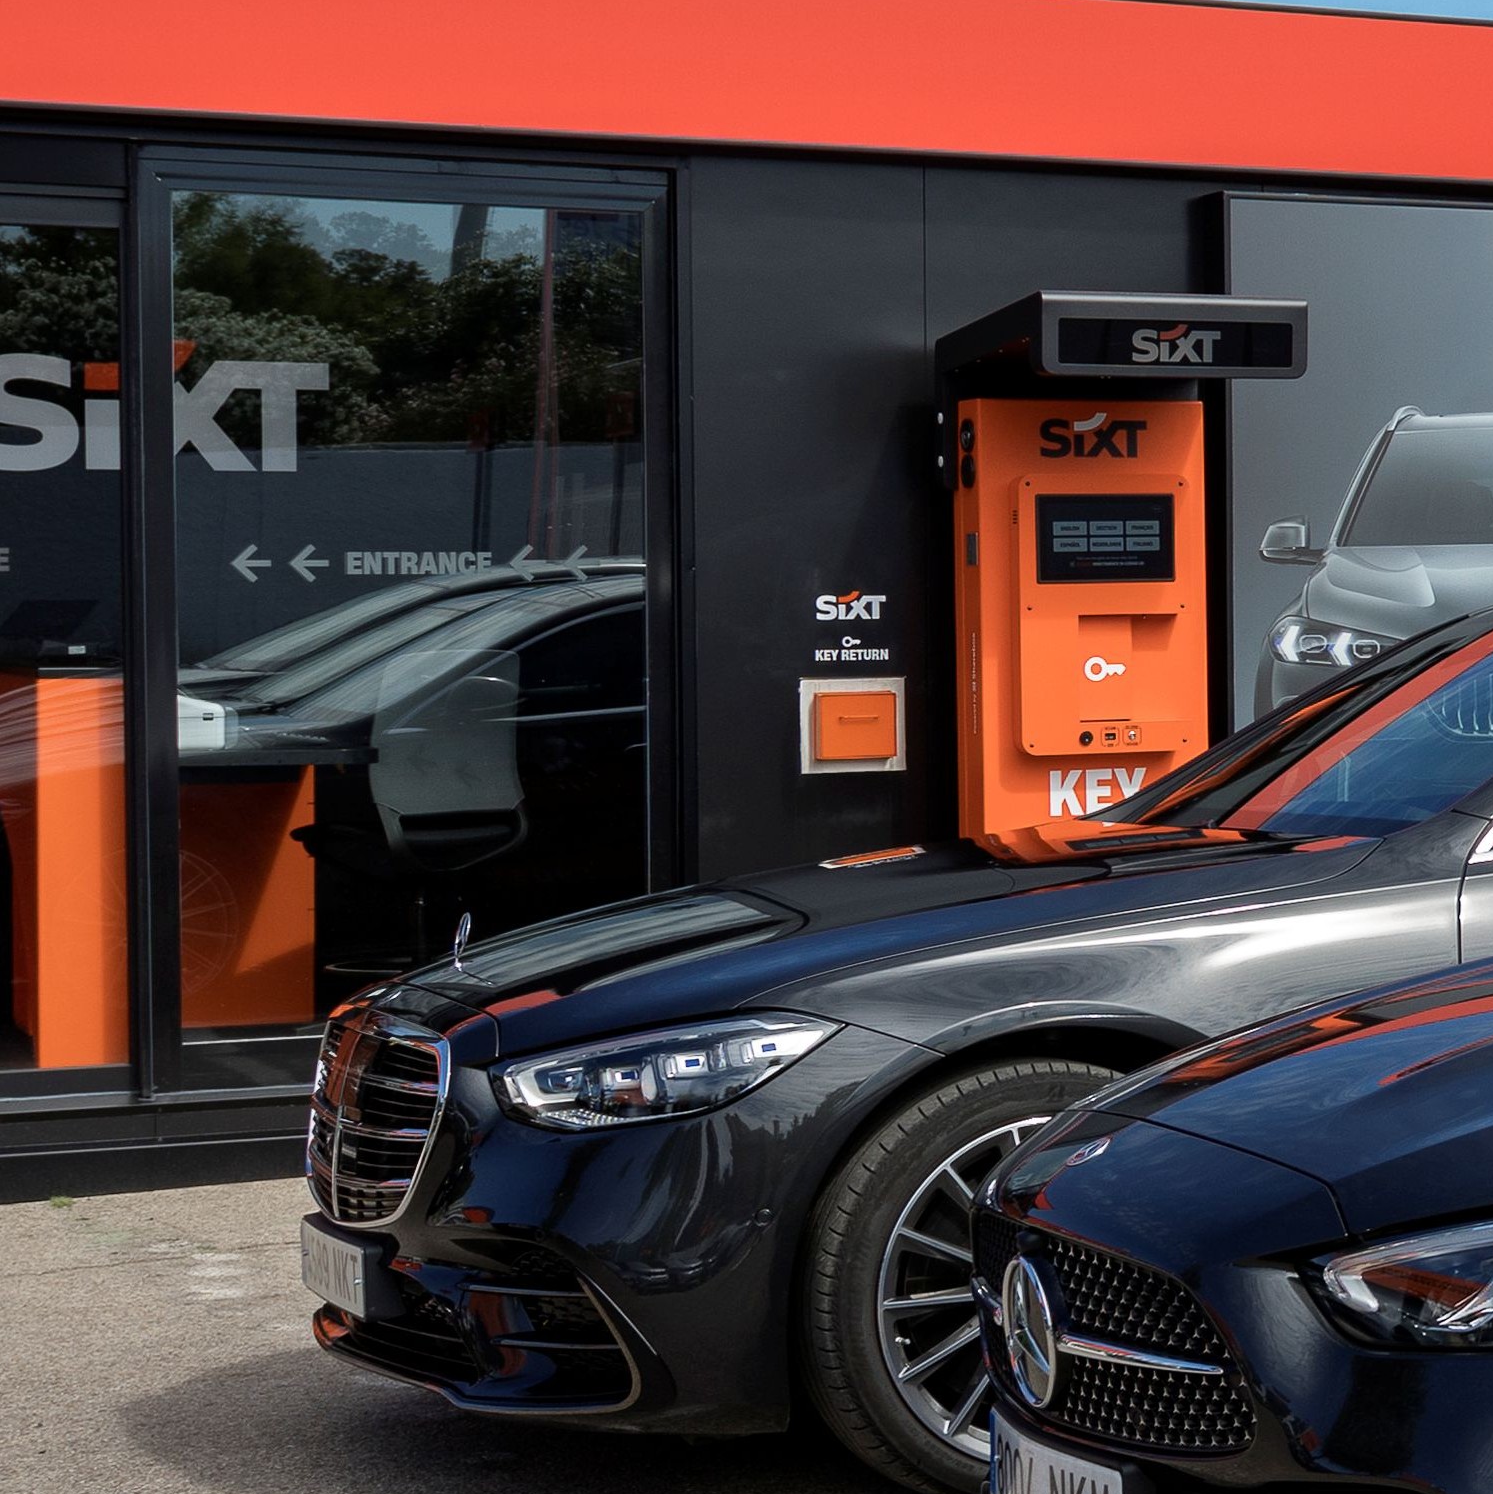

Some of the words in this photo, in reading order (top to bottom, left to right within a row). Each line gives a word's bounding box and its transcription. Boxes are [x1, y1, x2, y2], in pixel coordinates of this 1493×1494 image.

[346, 551, 492, 575] ENTRANCE
[815, 649, 838, 662] KEY
[841, 649, 889, 662] RETURN
[1049, 767, 1147, 817] KEY
[332, 1246, 358, 1304] NKT
